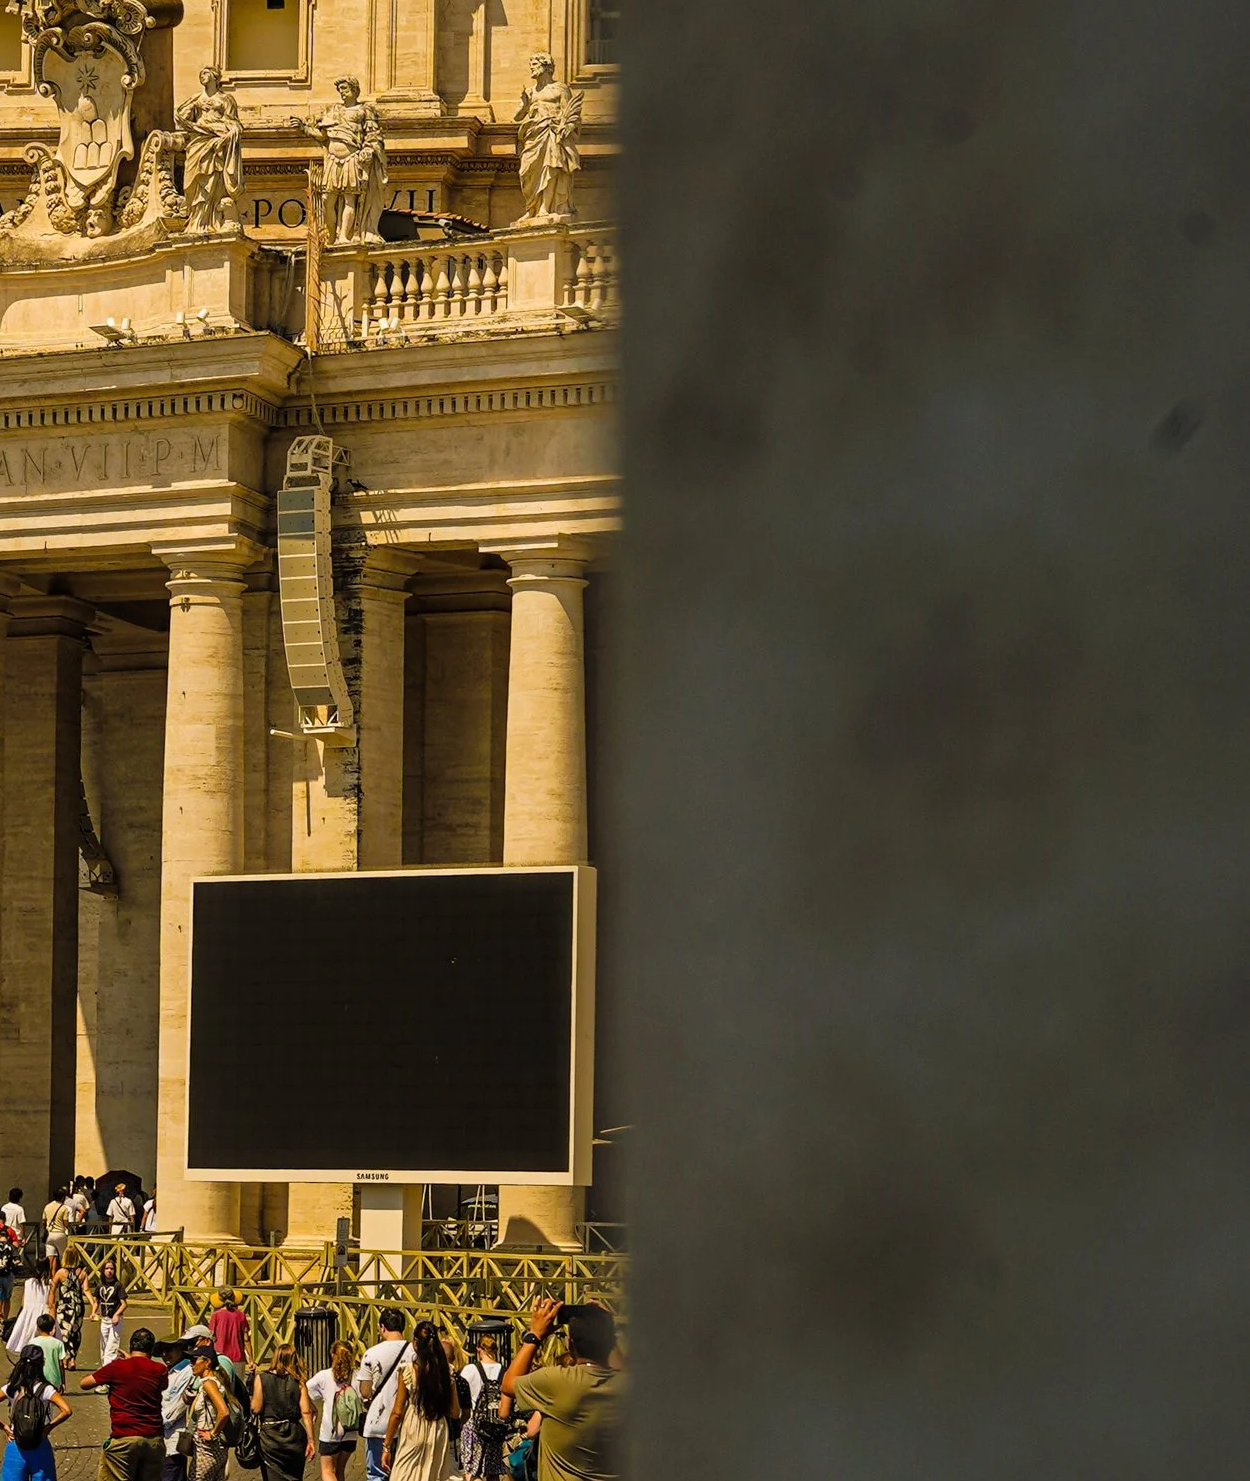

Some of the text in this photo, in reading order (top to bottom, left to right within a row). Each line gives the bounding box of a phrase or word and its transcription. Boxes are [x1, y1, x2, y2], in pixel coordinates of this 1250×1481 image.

[70, 442, 132, 482] VII
[150, 437, 172, 477] P
[190, 434, 223, 473] M
